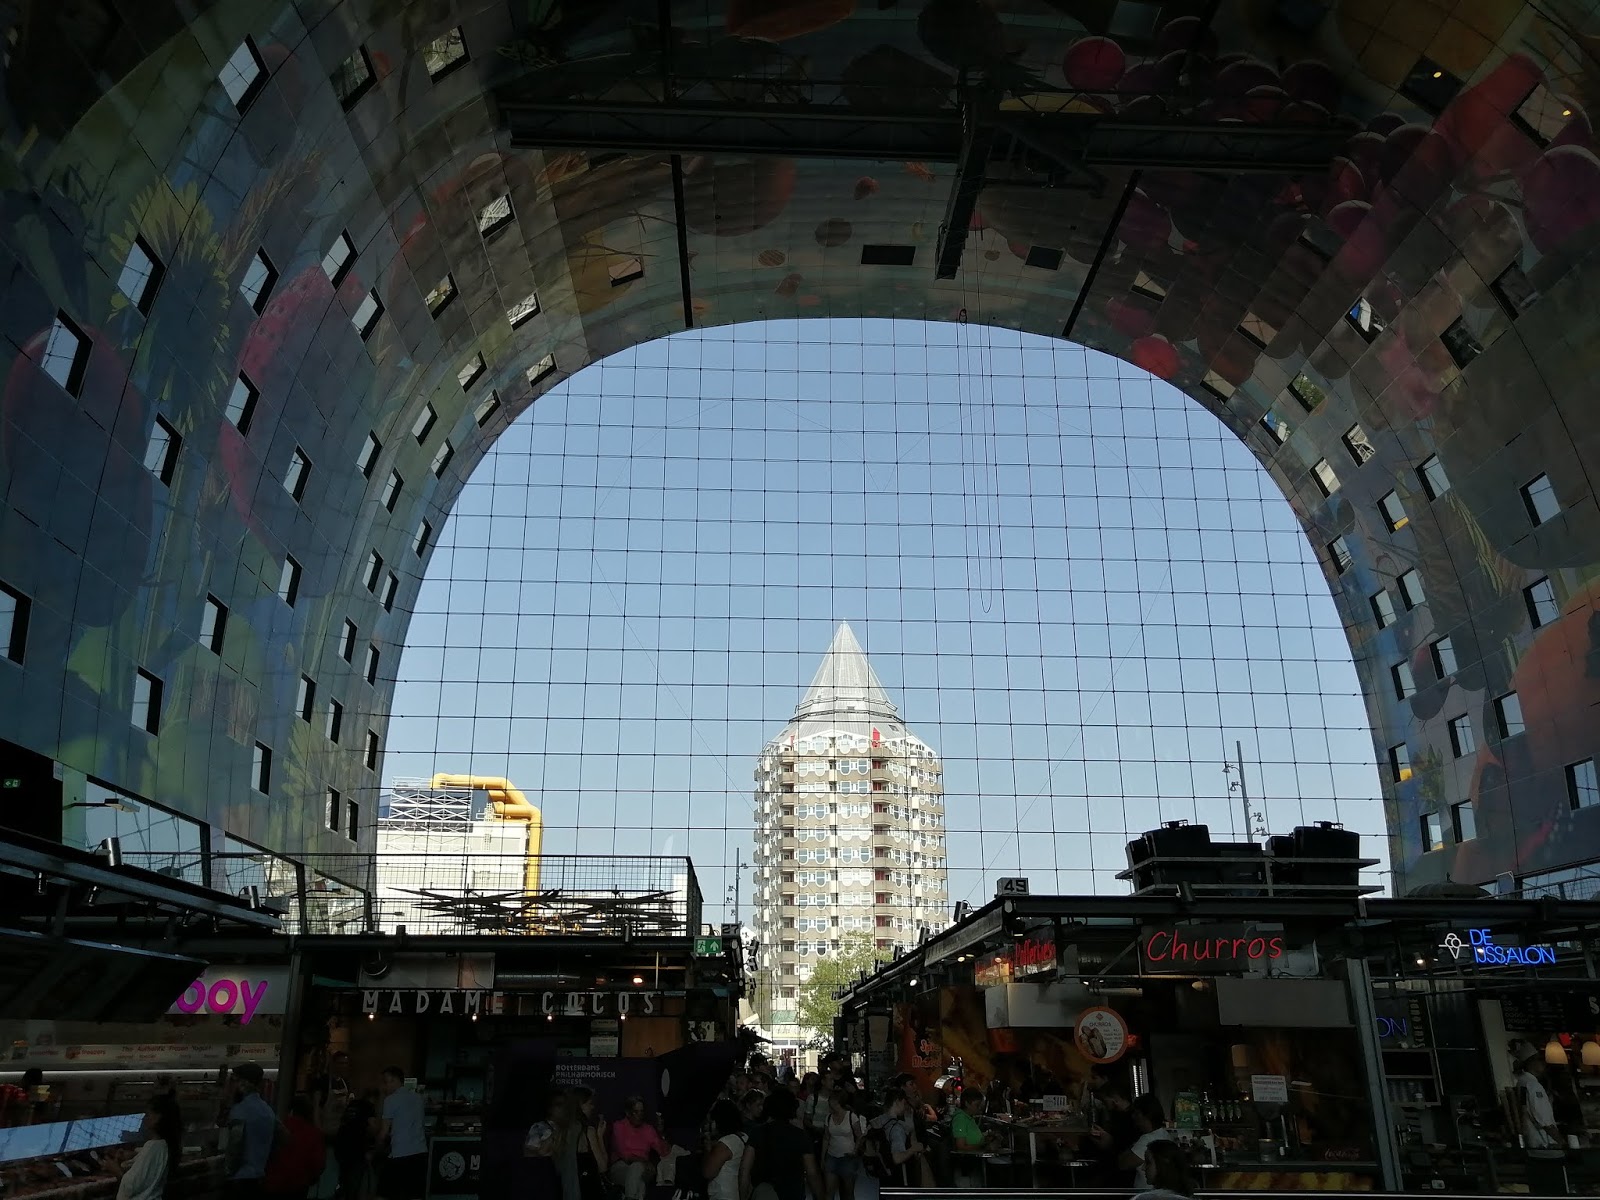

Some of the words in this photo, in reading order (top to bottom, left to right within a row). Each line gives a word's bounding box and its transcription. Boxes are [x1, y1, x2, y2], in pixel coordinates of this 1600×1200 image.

[1003, 878, 1027, 893] 49
[721, 924, 740, 935] 27
[1469, 928, 1494, 946] DE
[1146, 929, 1283, 962] Churros
[362, 990, 505, 1014] MADAME
[541, 991, 656, 1015] COCOS
